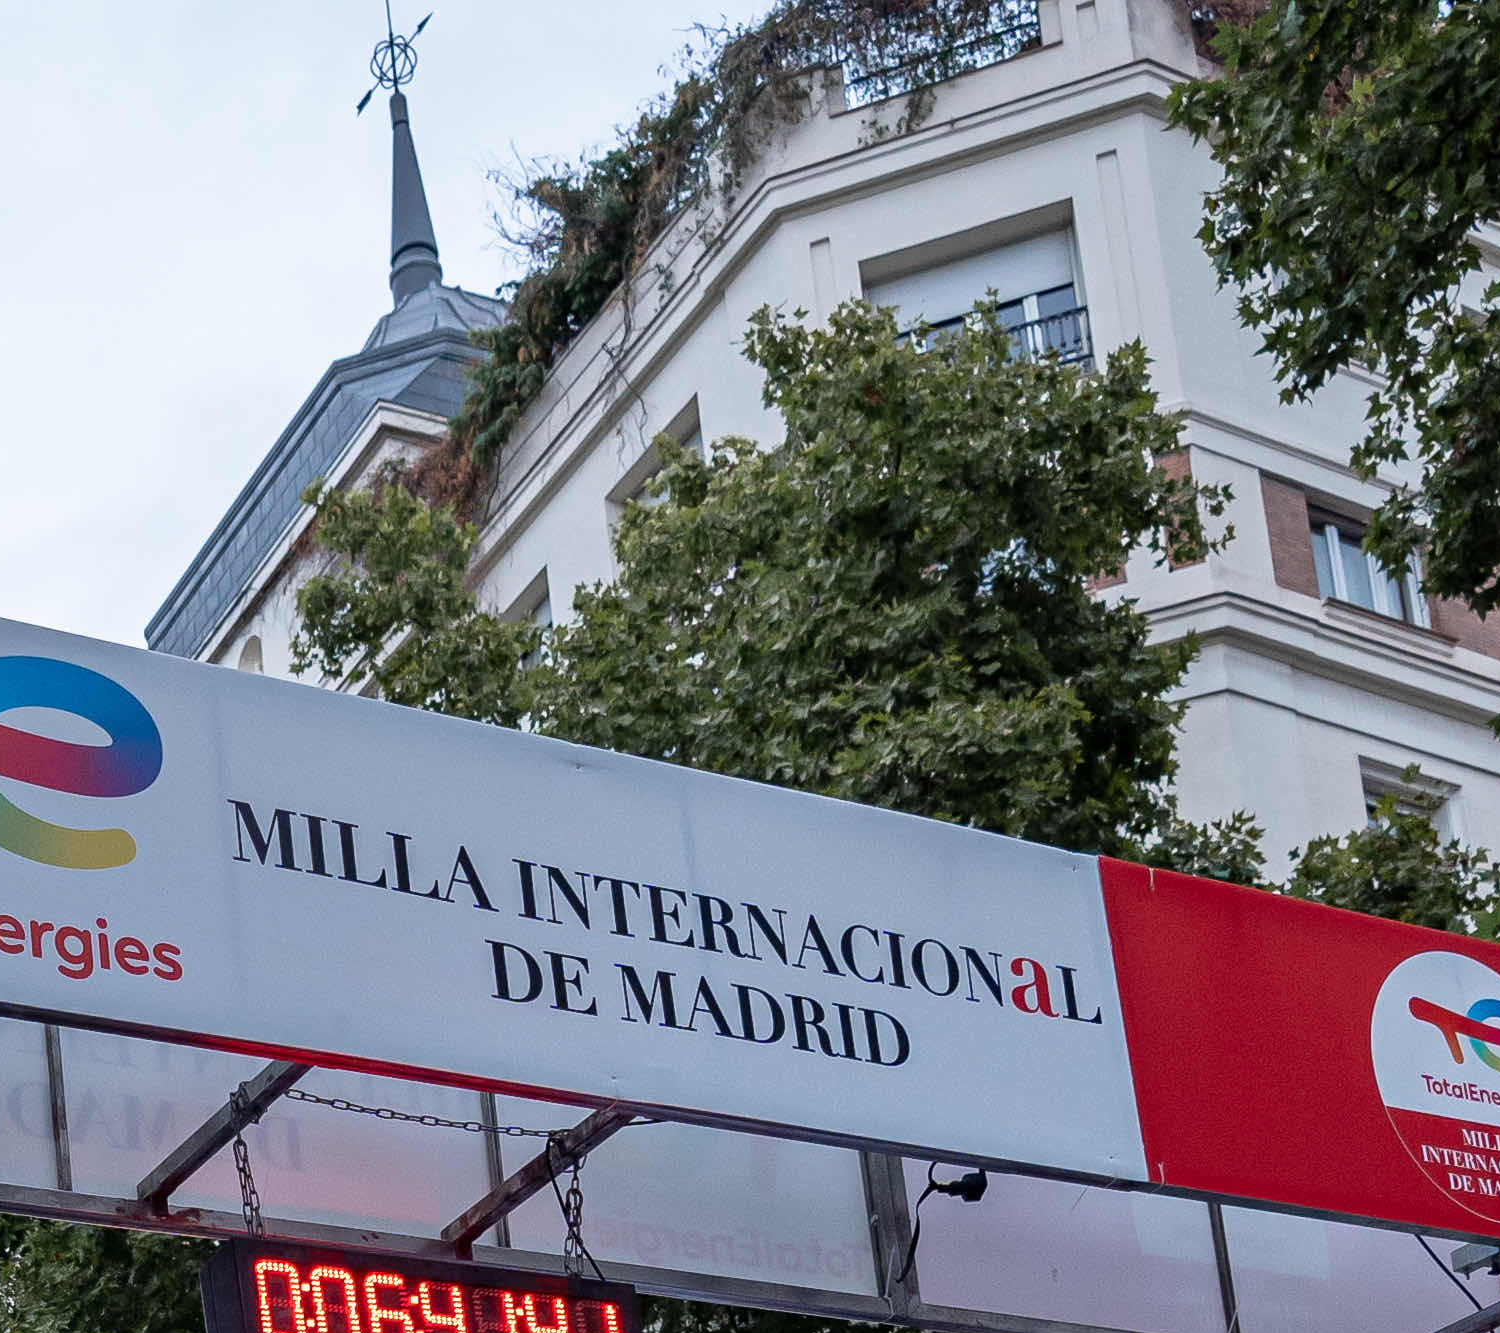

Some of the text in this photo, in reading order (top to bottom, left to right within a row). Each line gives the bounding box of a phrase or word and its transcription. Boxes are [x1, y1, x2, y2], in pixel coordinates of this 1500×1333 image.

[227, 799, 499, 914] MILLA
[484, 939, 911, 1068] DE MADRID
[1448, 1172, 1475, 1193] DE
